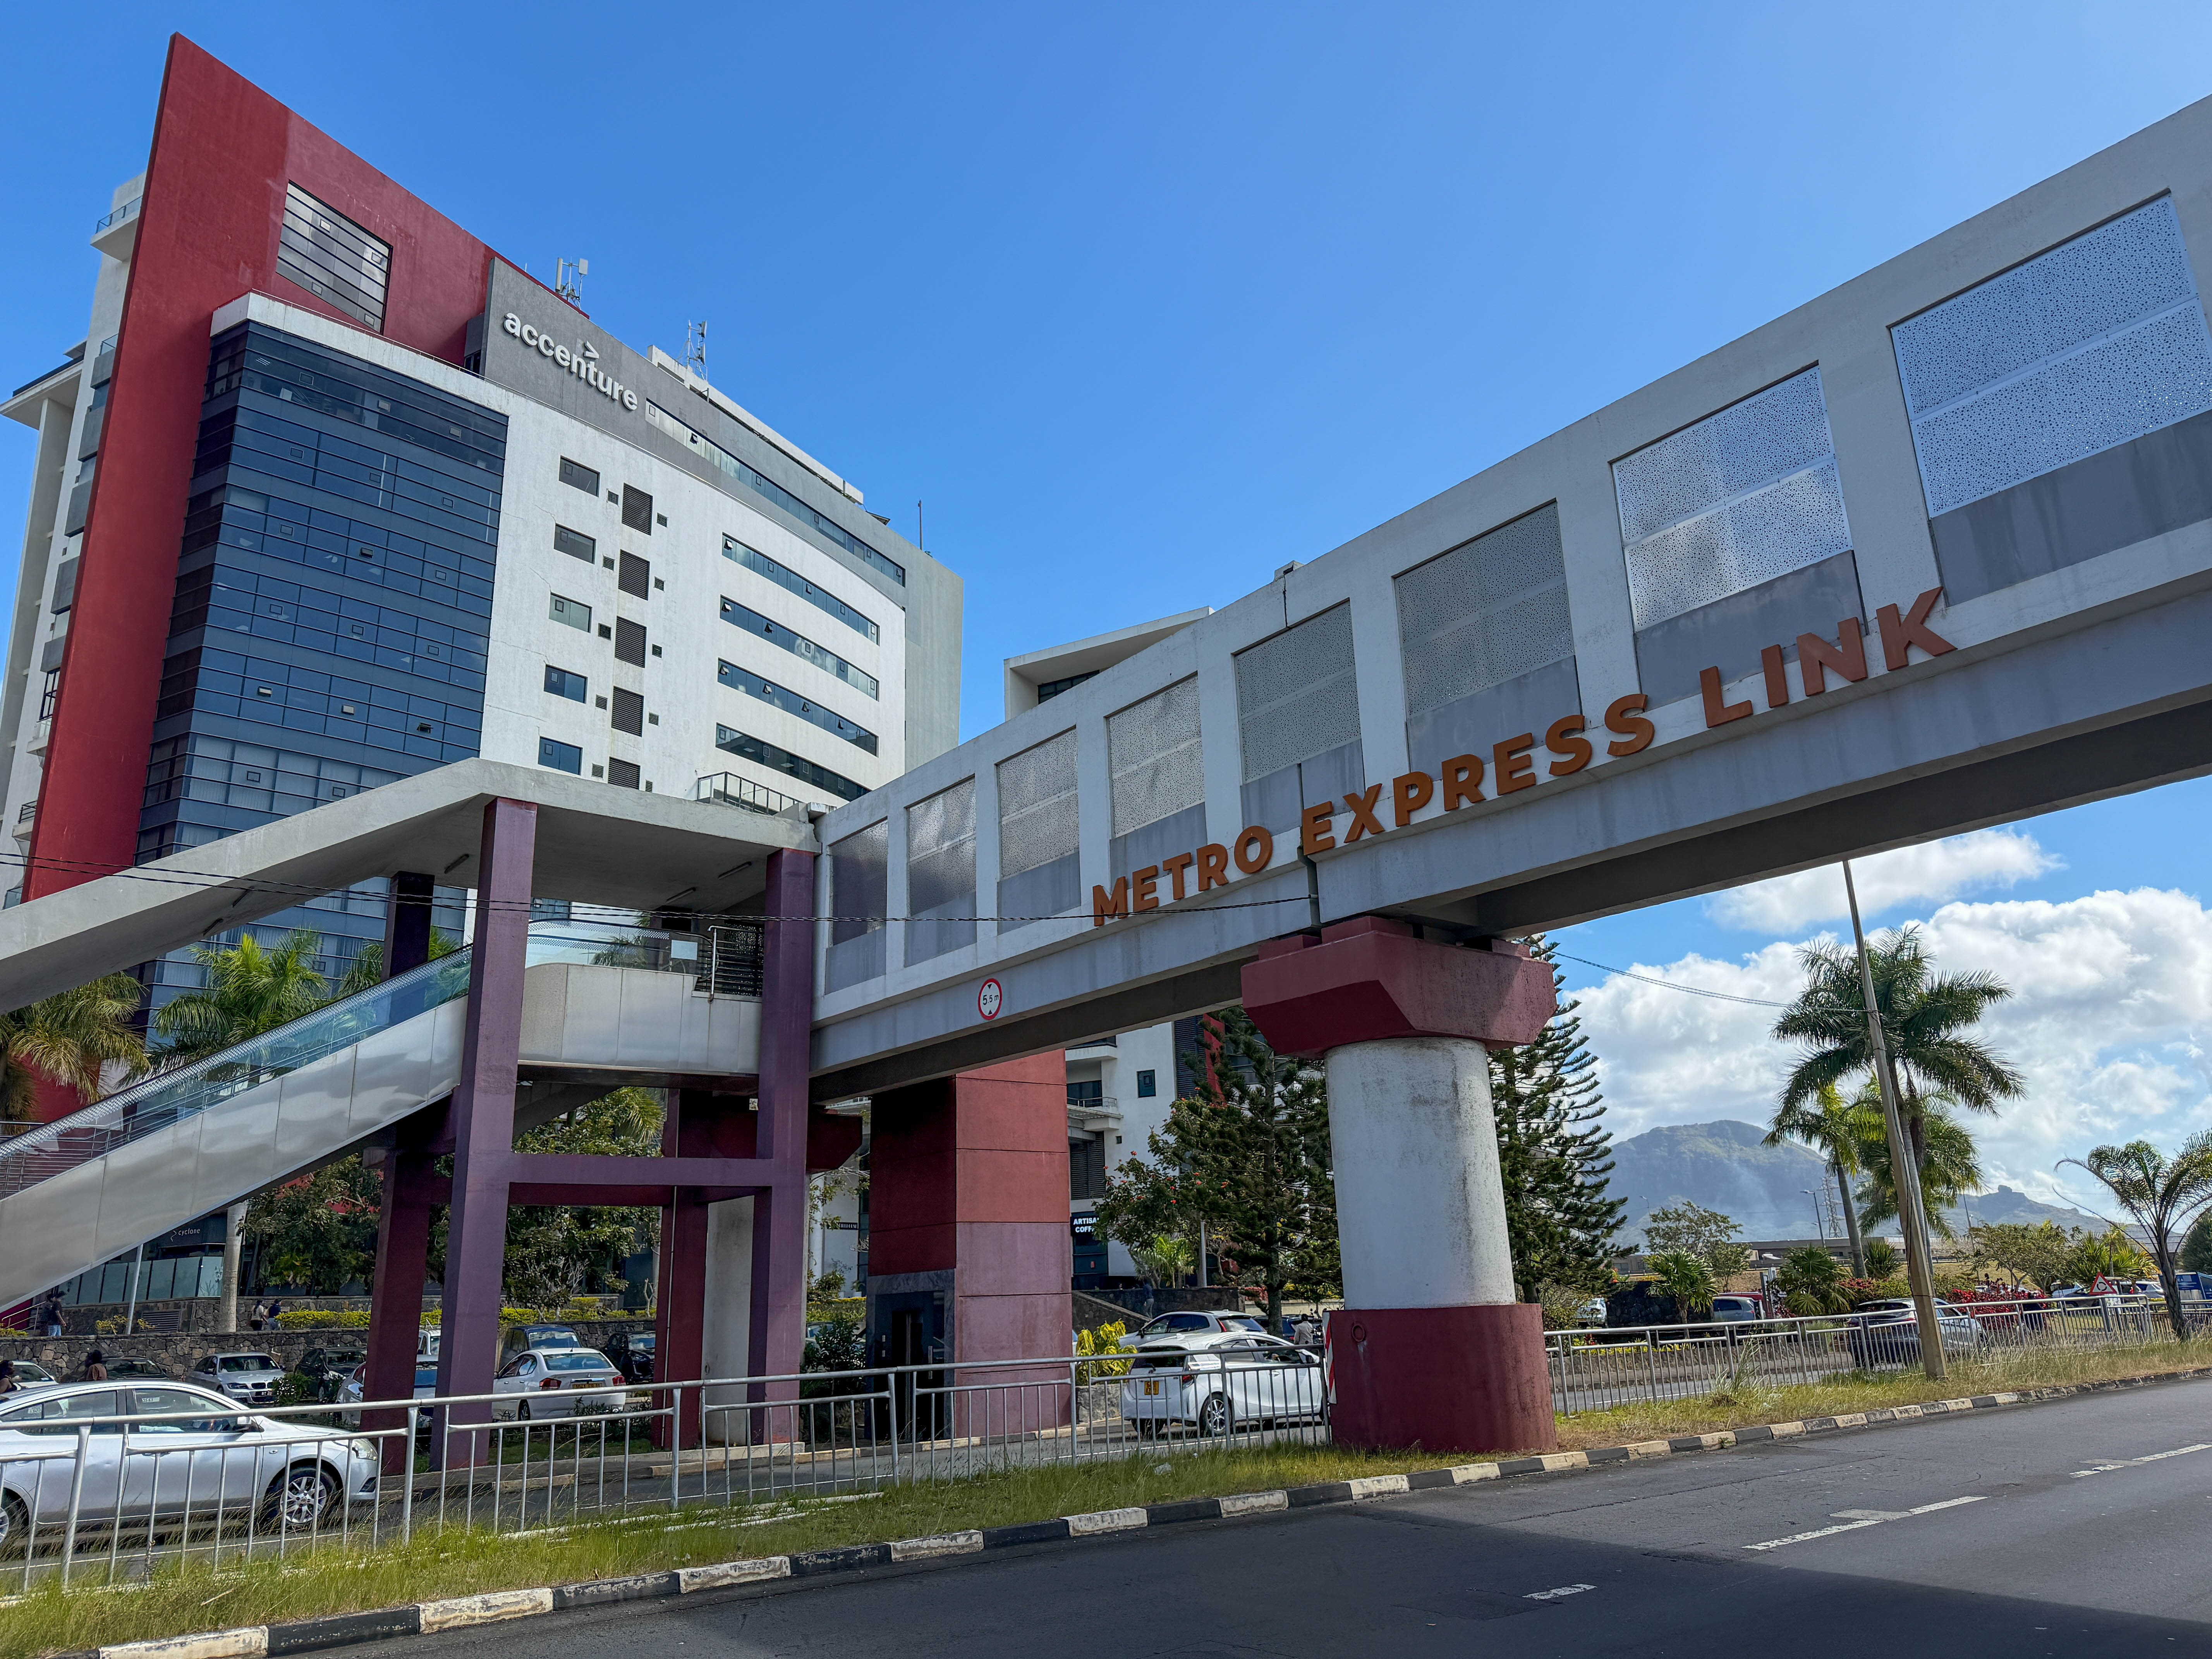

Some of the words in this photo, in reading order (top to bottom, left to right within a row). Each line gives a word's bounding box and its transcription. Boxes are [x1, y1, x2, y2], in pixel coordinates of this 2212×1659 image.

[503, 313, 638, 411] accenture
[1092, 825, 1273, 927] METRO
[1302, 694, 1655, 855] EXPRESS
[1700, 586, 1958, 728] LINK
[983, 994, 993, 1005] 5.5
